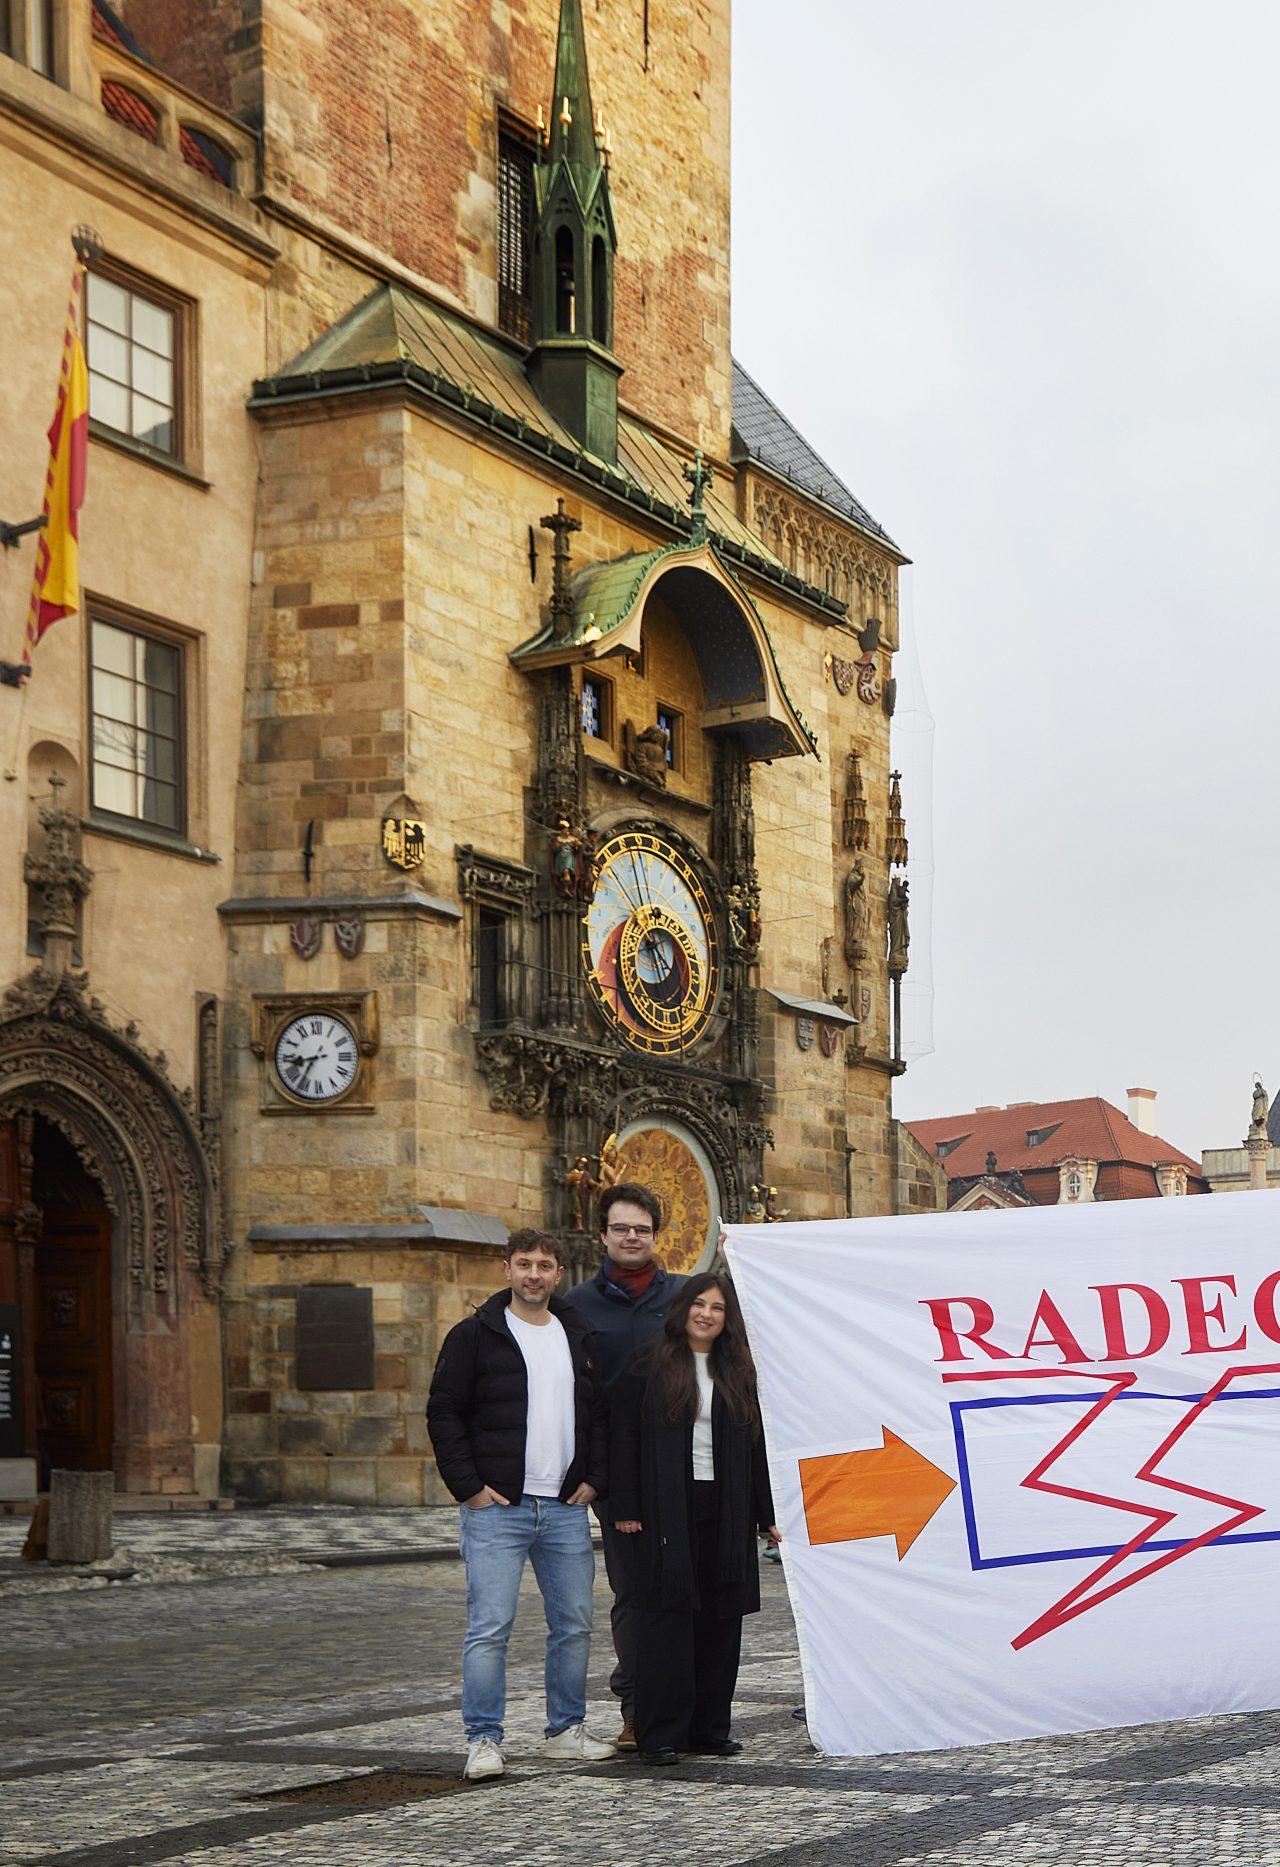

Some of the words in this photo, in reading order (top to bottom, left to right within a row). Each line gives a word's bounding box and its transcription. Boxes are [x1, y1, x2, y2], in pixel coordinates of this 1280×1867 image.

[311, 1021, 322, 1035] XII
[327, 1025, 335, 1038] I
[339, 1052, 352, 1061] III
